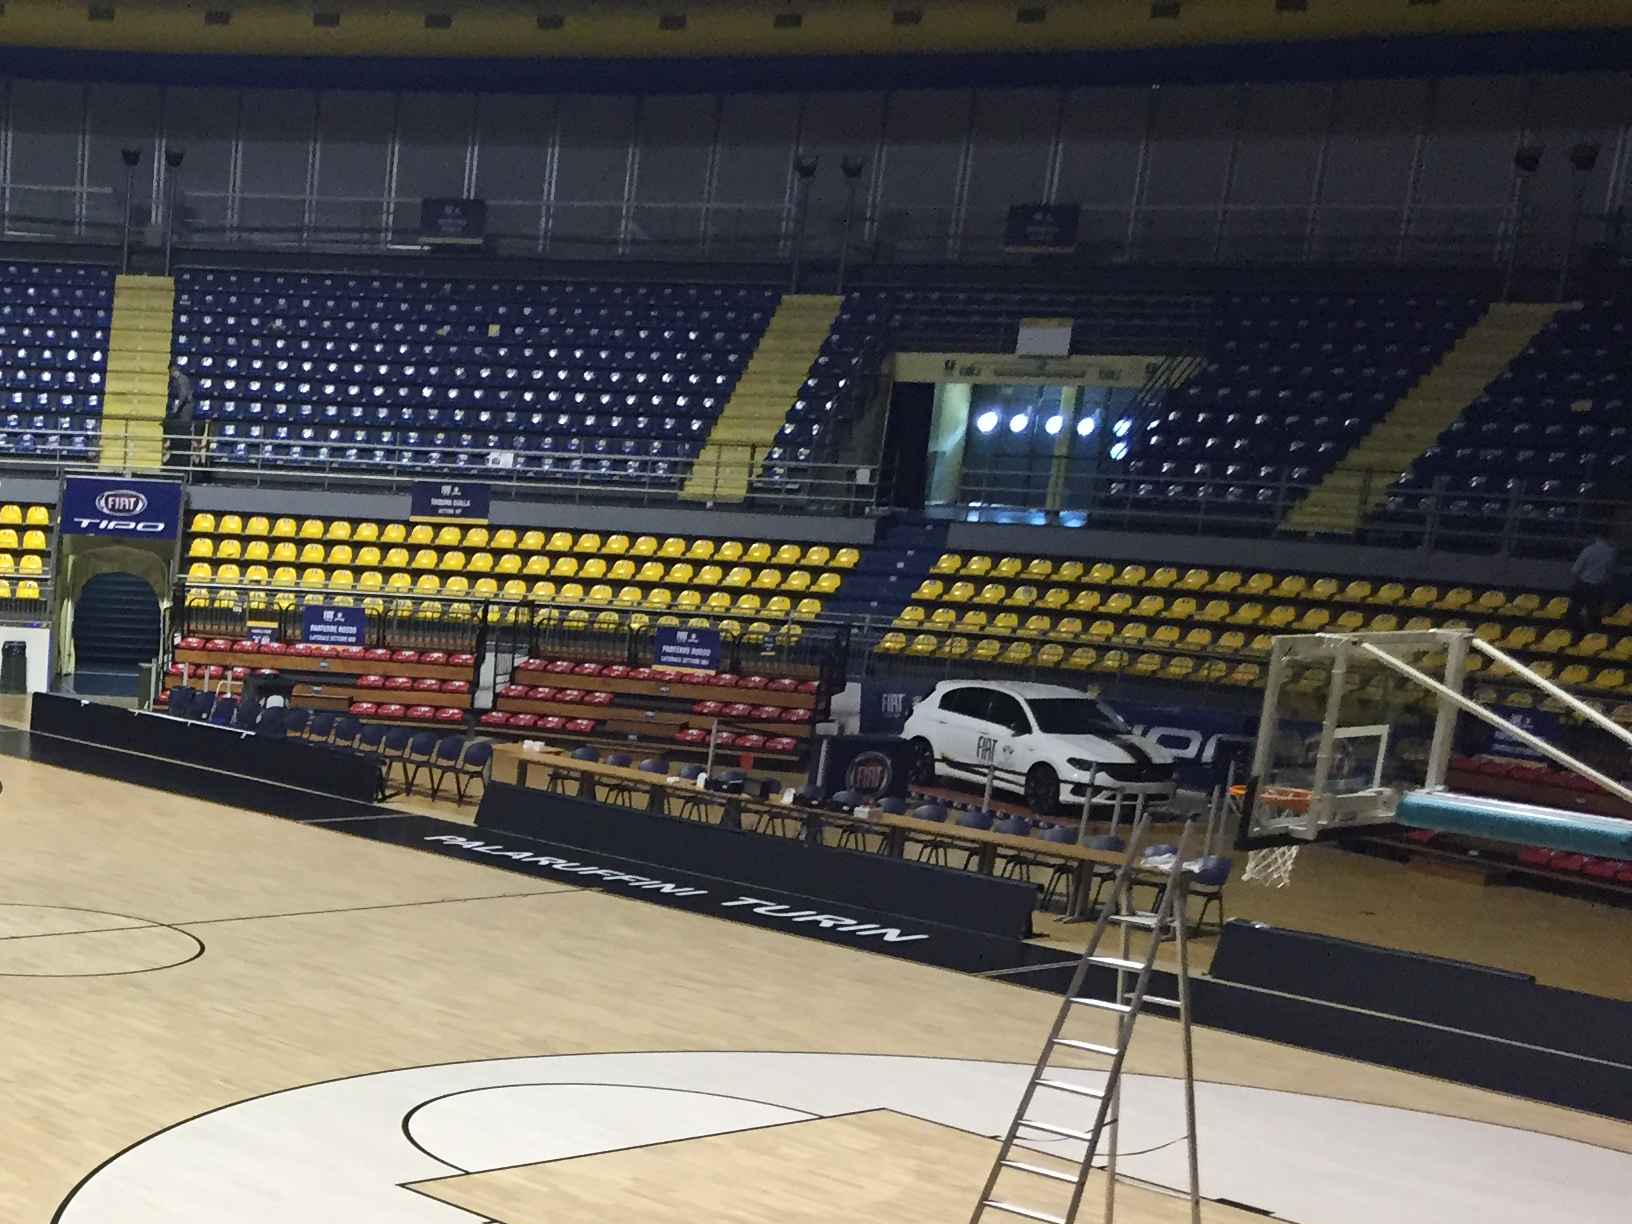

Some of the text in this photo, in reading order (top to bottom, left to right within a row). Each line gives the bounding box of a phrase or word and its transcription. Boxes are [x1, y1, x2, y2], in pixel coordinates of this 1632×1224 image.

[107, 496, 137, 511] FIAT
[73, 518, 166, 532] TIPO
[881, 693, 906, 713] FIAT
[976, 735, 999, 762] FIAT
[424, 834, 930, 943] PALARUFFINI TURIN
